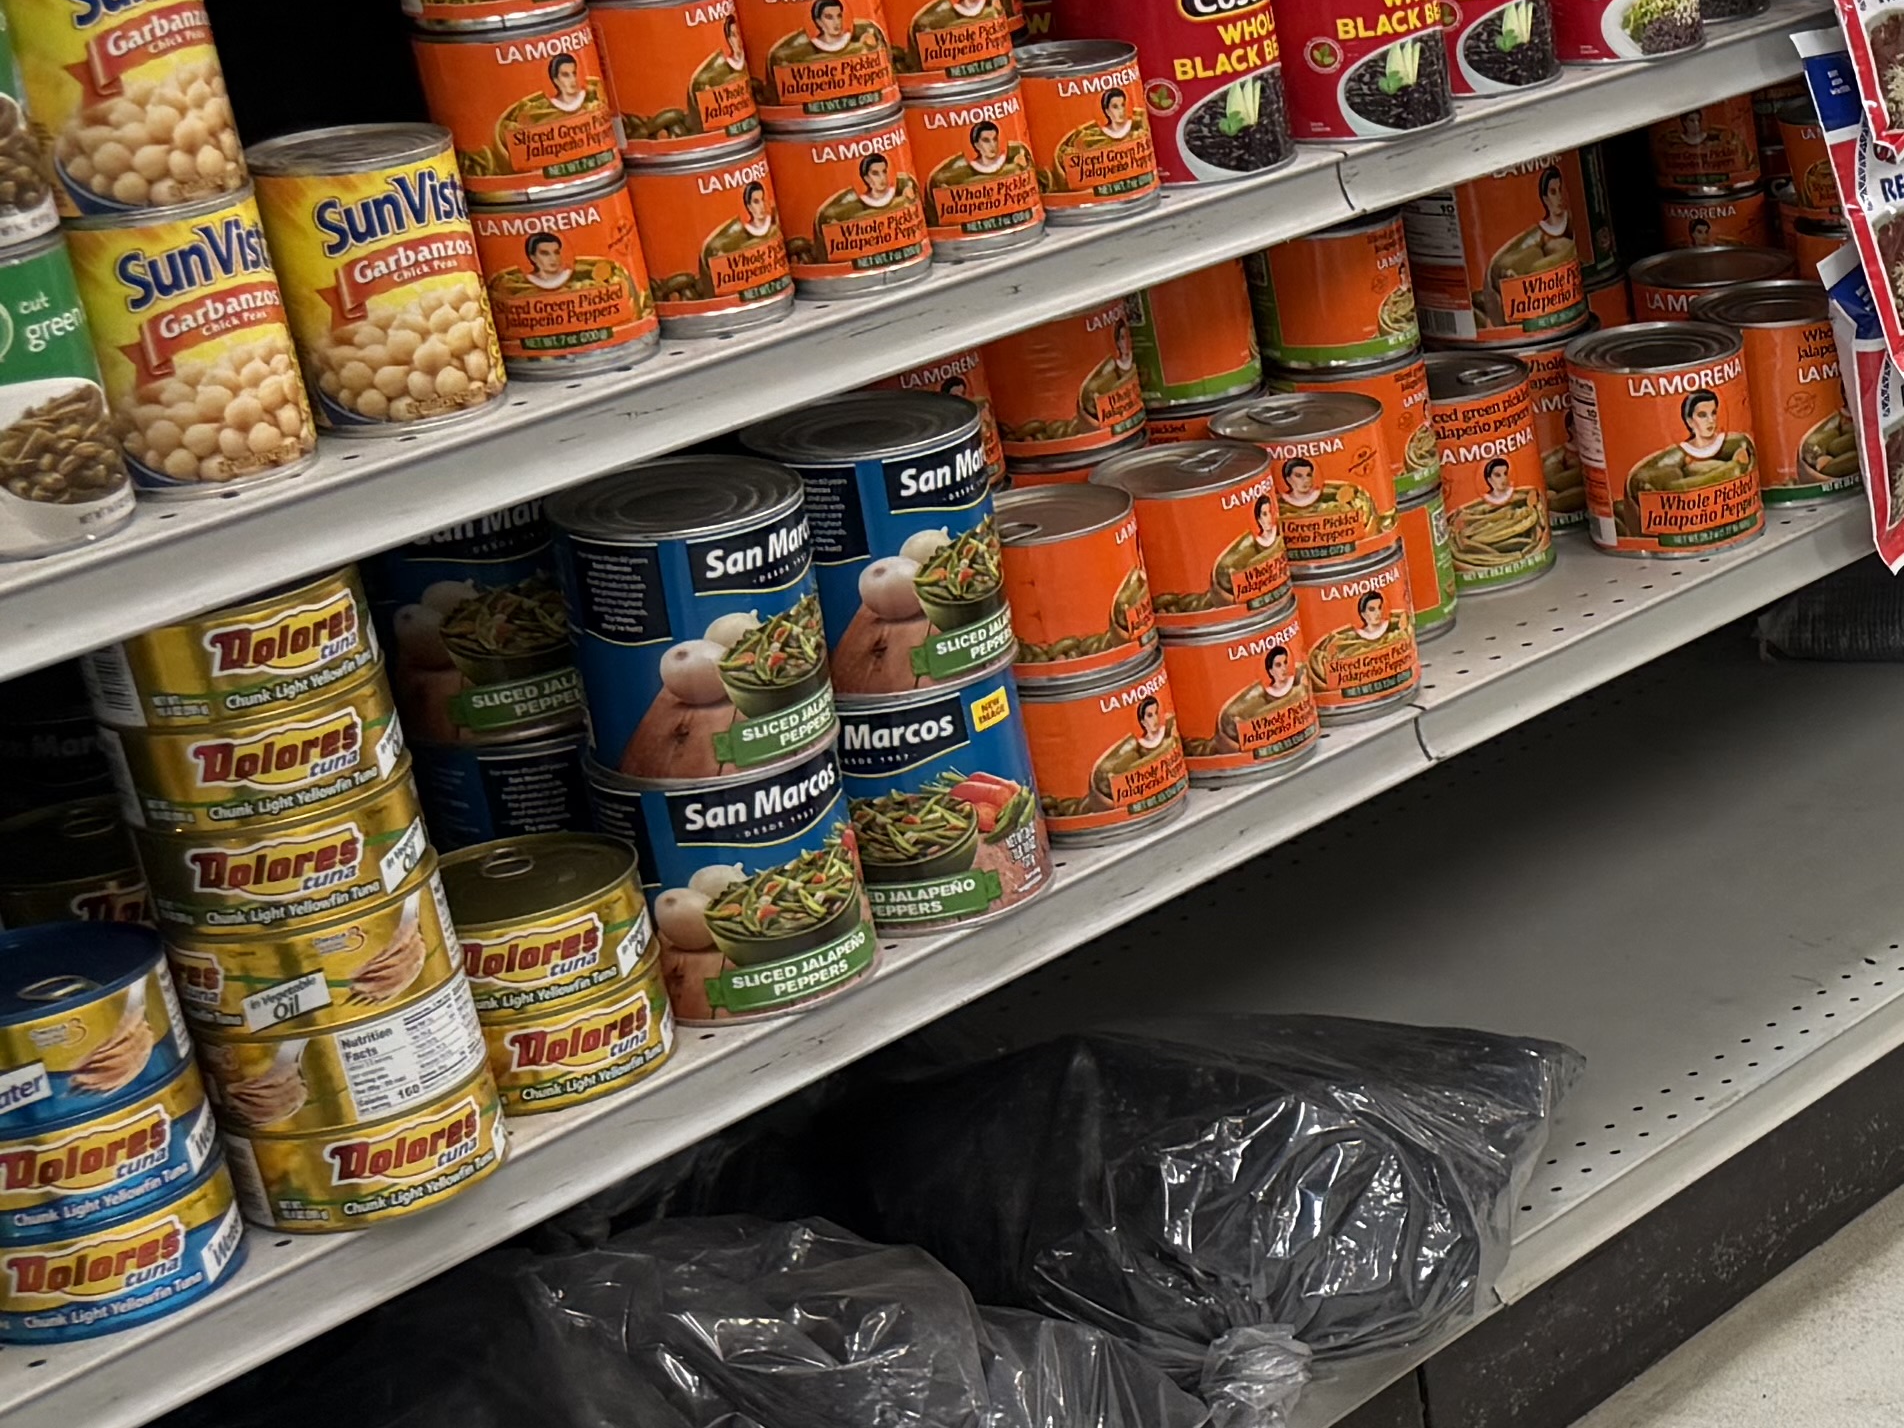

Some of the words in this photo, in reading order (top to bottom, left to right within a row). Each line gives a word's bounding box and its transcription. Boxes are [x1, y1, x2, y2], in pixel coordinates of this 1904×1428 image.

[1337, 6, 1421, 41] BLACK
[780, 74, 845, 97] Jalapeño
[790, 63, 833, 86] Whole
[834, 53, 883, 80] Pickled
[923, 109, 948, 131] LA
[949, 96, 1021, 128] MORENA
[478, 216, 501, 239] LA
[501, 205, 601, 235] MORENA
[353, 236, 473, 286] Garbanzos
[392, 267, 427, 285] Chick
[428, 259, 460, 277] Peas
[18, 295, 51, 316] cut
[158, 288, 279, 340] Garbanzos
[502, 308, 564, 331] Jalapeño
[565, 298, 622, 324] Peppers
[541, 296, 576, 318] Green
[579, 284, 624, 311] Pickled
[24, 307, 84, 353] green
[201, 316, 235, 335] Chick
[237, 308, 269, 329] Peas
[1628, 373, 1659, 397] LA
[1660, 358, 1745, 395] MORENA
[1659, 489, 1705, 515] Whole
[1707, 475, 1755, 504] Pickled
[1645, 506, 1716, 530] Jalapeño
[705, 546, 764, 580] San
[1319, 582, 1343, 602] LA
[1343, 567, 1401, 599] MORENA
[209, 603, 357, 672] Dolores
[319, 629, 358, 660] tuna
[225, 684, 273, 711] Chunk
[274, 676, 309, 700] Light
[741, 712, 799, 744] SLICED
[843, 714, 955, 751] Marcos
[193, 720, 360, 783] Dolores
[308, 749, 359, 779] tuna
[684, 798, 747, 832] San
[753, 762, 836, 820] Marcos
[189, 835, 361, 889] Dolores
[301, 864, 358, 892] tuna
[206, 903, 248, 926] Chunk
[250, 900, 286, 924] Light
[288, 888, 350, 918] Yellowfin
[351, 878, 381, 900] Tuna
[889, 877, 977, 904] JALAPEÑO
[731, 964, 798, 990] SLICED
[800, 931, 867, 974] JALAPEÑO
[773, 959, 849, 997] PEPPERS
[272, 995, 300, 1021] Oil
[510, 1001, 648, 1069] Dolores
[608, 1028, 648, 1060] tuna
[329, 1108, 478, 1181] Dolores
[436, 1136, 478, 1168] tuna
[6, 1227, 182, 1297] Dolores
[121, 1257, 181, 1289] tuna
